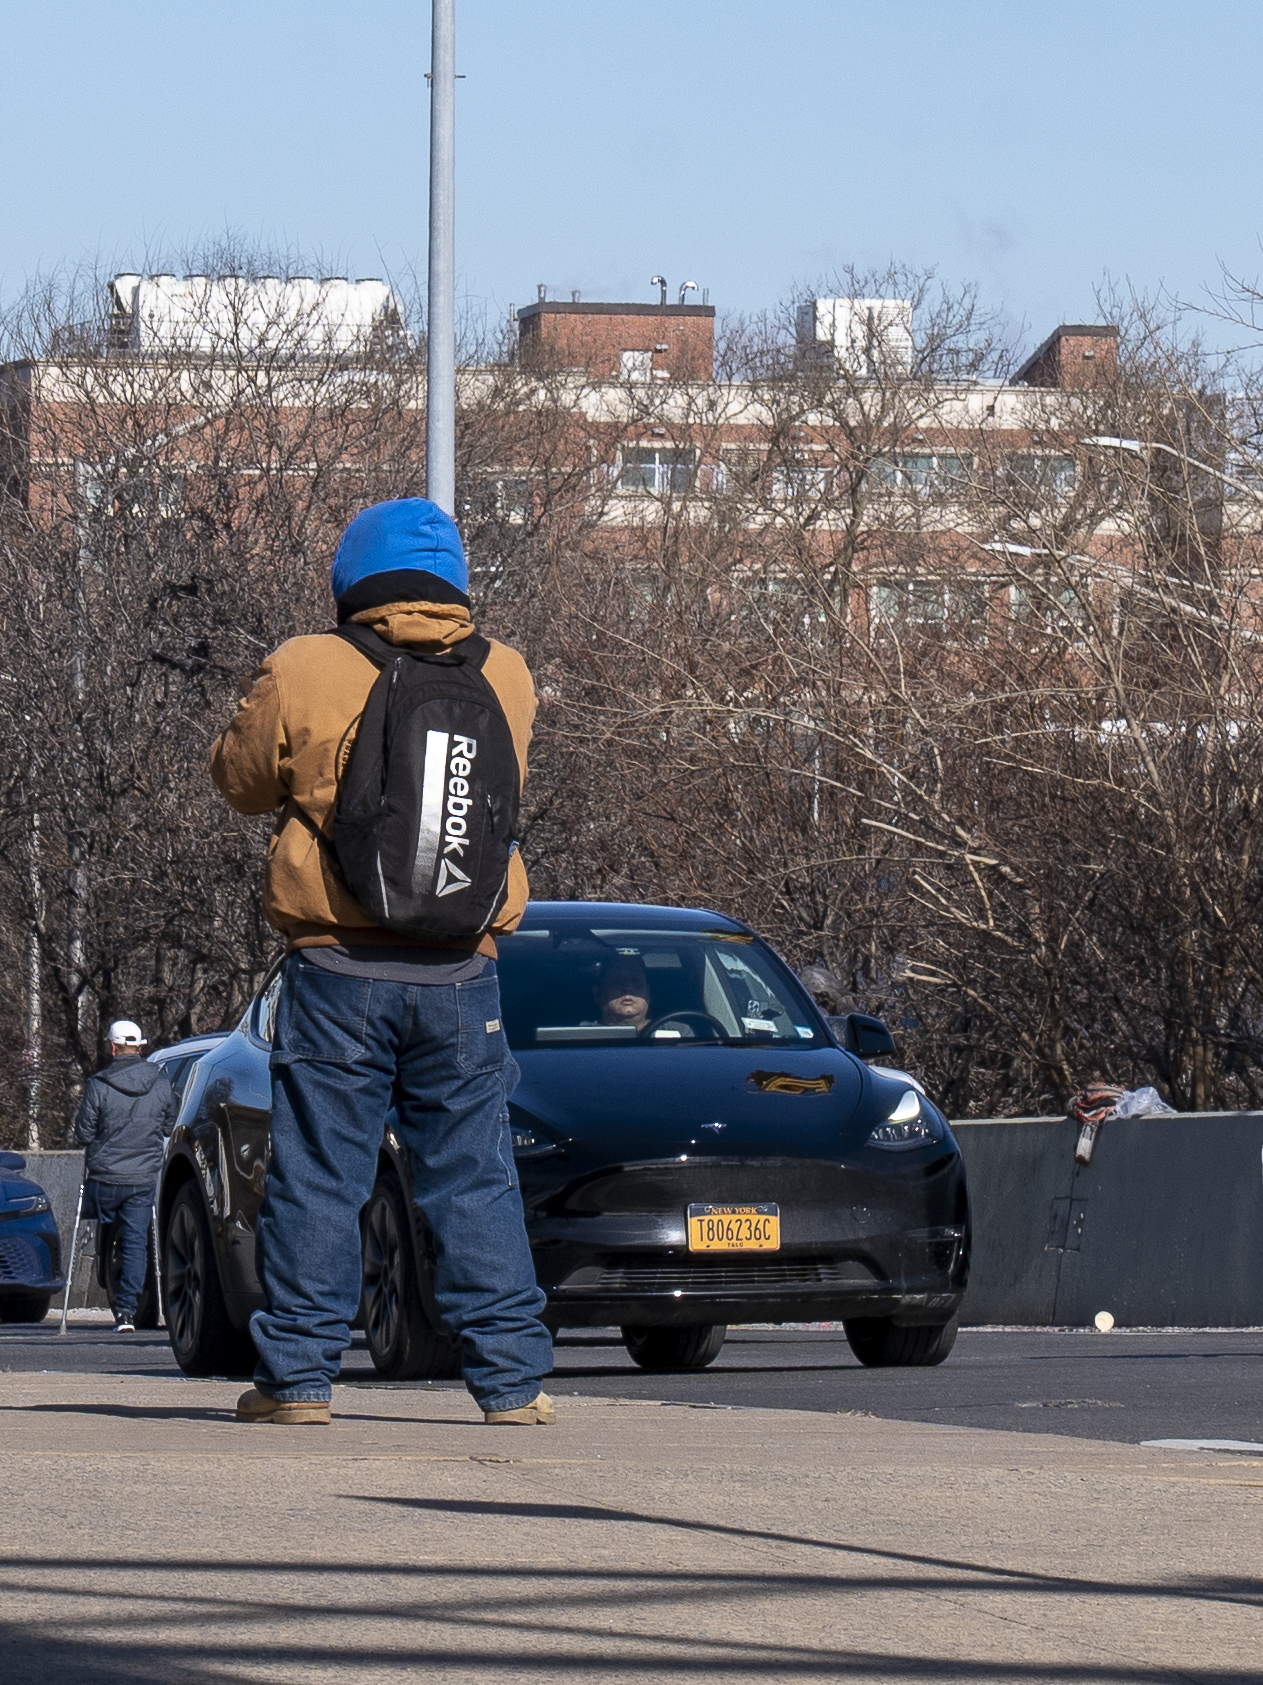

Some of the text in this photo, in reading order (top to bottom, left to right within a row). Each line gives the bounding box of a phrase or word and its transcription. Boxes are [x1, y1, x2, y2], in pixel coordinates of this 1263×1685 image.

[443, 734, 477, 857] Reebok
[711, 1207, 732, 1215] NEW
[697, 1217, 771, 1242] T806236C
